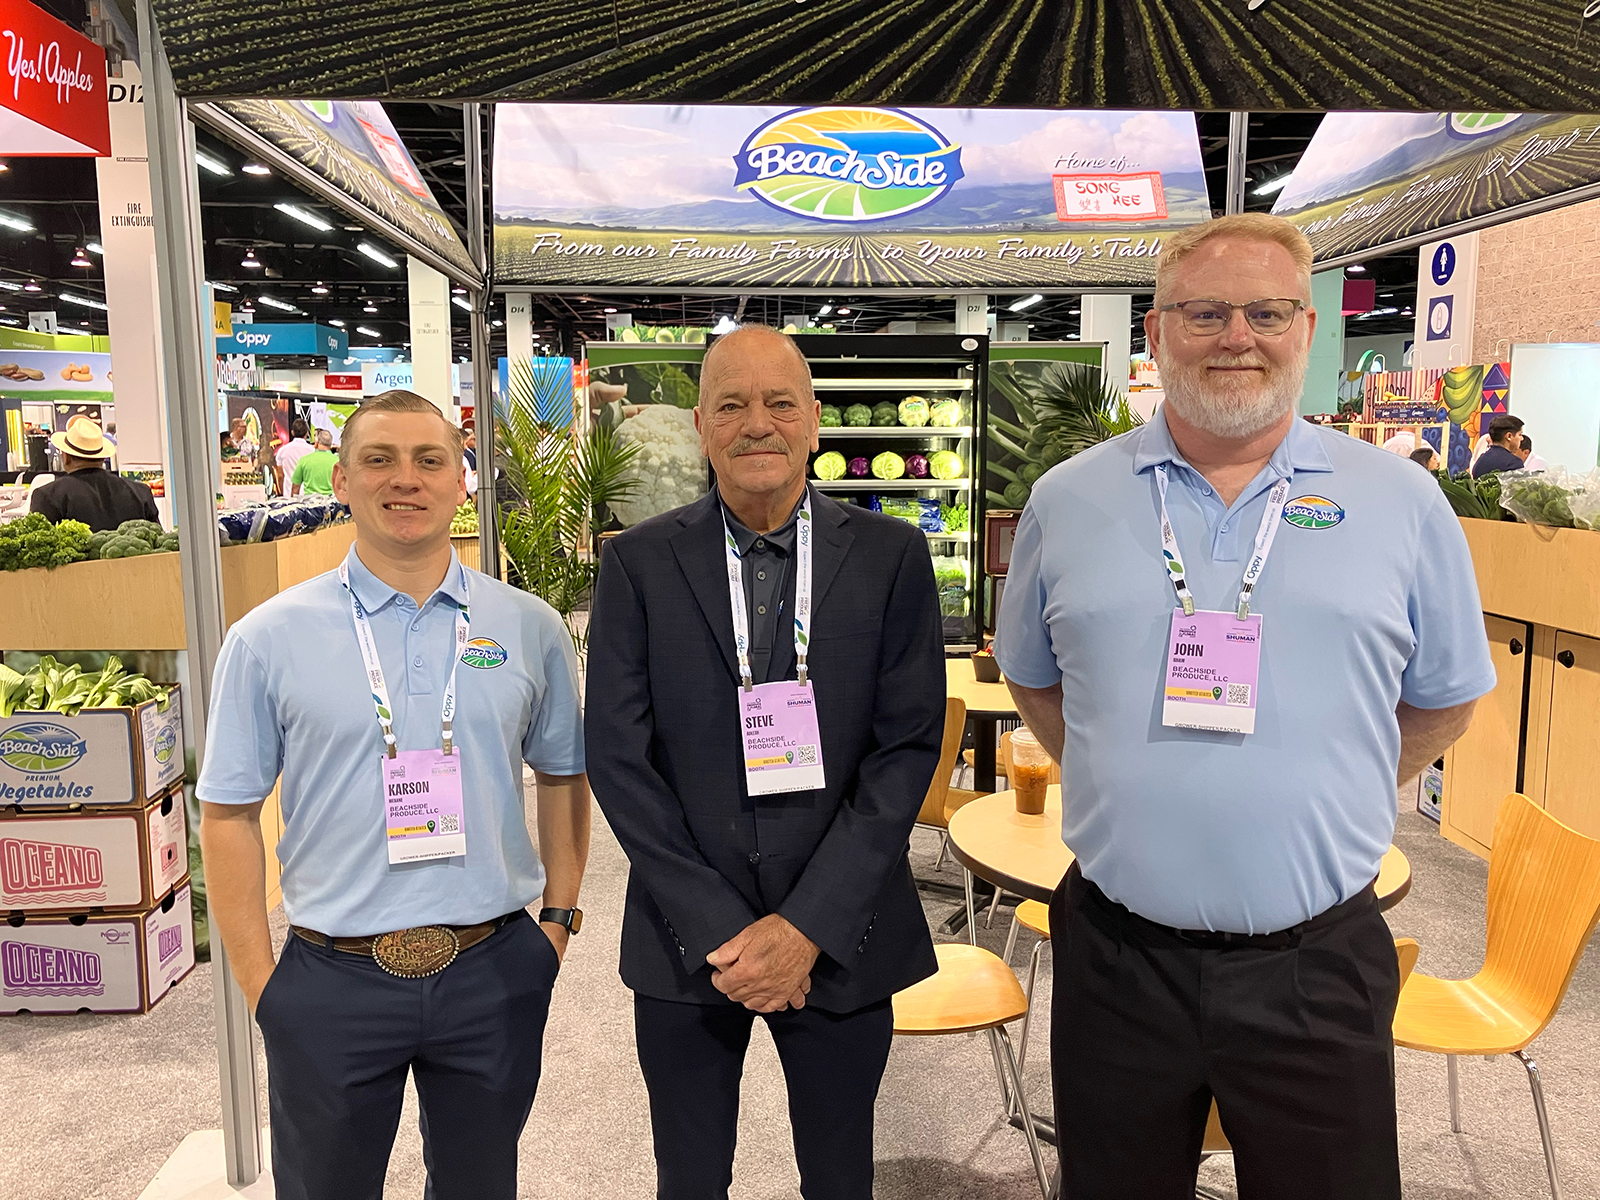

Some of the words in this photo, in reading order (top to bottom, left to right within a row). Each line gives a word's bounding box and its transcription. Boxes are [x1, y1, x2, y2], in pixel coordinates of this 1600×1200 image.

[2, 30, 43, 100] Yes!
[45, 41, 93, 103] Apples
[1054, 150, 1106, 169] Home
[748, 145, 948, 189] BeachSide
[1075, 182, 1120, 194] SONG
[1303, 215, 1332, 236] our
[1331, 197, 1395, 229] Family
[1477, 152, 1505, 180] to
[1505, 127, 1581, 178] Your
[1111, 194, 1141, 207] HEE
[127, 203, 142, 214] FIRE
[531, 232, 605, 256] From
[612, 242, 659, 257] our
[668, 237, 759, 266] Family
[881, 242, 905, 260] to
[916, 239, 987, 266] Your
[997, 237, 1102, 265] Family's
[967, 305, 981, 313] D21
[235, 330, 272, 348] Oppy
[327, 335, 339, 351] Oppy
[1285, 506, 1341, 522] BeachSide
[800, 525, 810, 546] Oppy
[1246, 554, 1263, 580] Oppy
[1226, 634, 1256, 642] SHUMAN
[1174, 643, 1204, 657] JOHN
[1172, 672, 1212, 681] PRODUCE,
[1173, 666, 1217, 675] BEACHSIDE
[746, 715, 774, 729] STEVE
[748, 736, 785, 744] BEACHSIDE
[748, 741, 782, 750] PRODUCE,
[0, 740, 80, 759] BeachSide
[25, 774, 60, 782] PREMIUM
[389, 781, 429, 796] KARSON
[390, 803, 428, 811] BEACHSIDE
[390, 809, 425, 817] PRODUCE,
[3, 839, 102, 891] OCEANO
[6, 941, 101, 986] OCEANO
